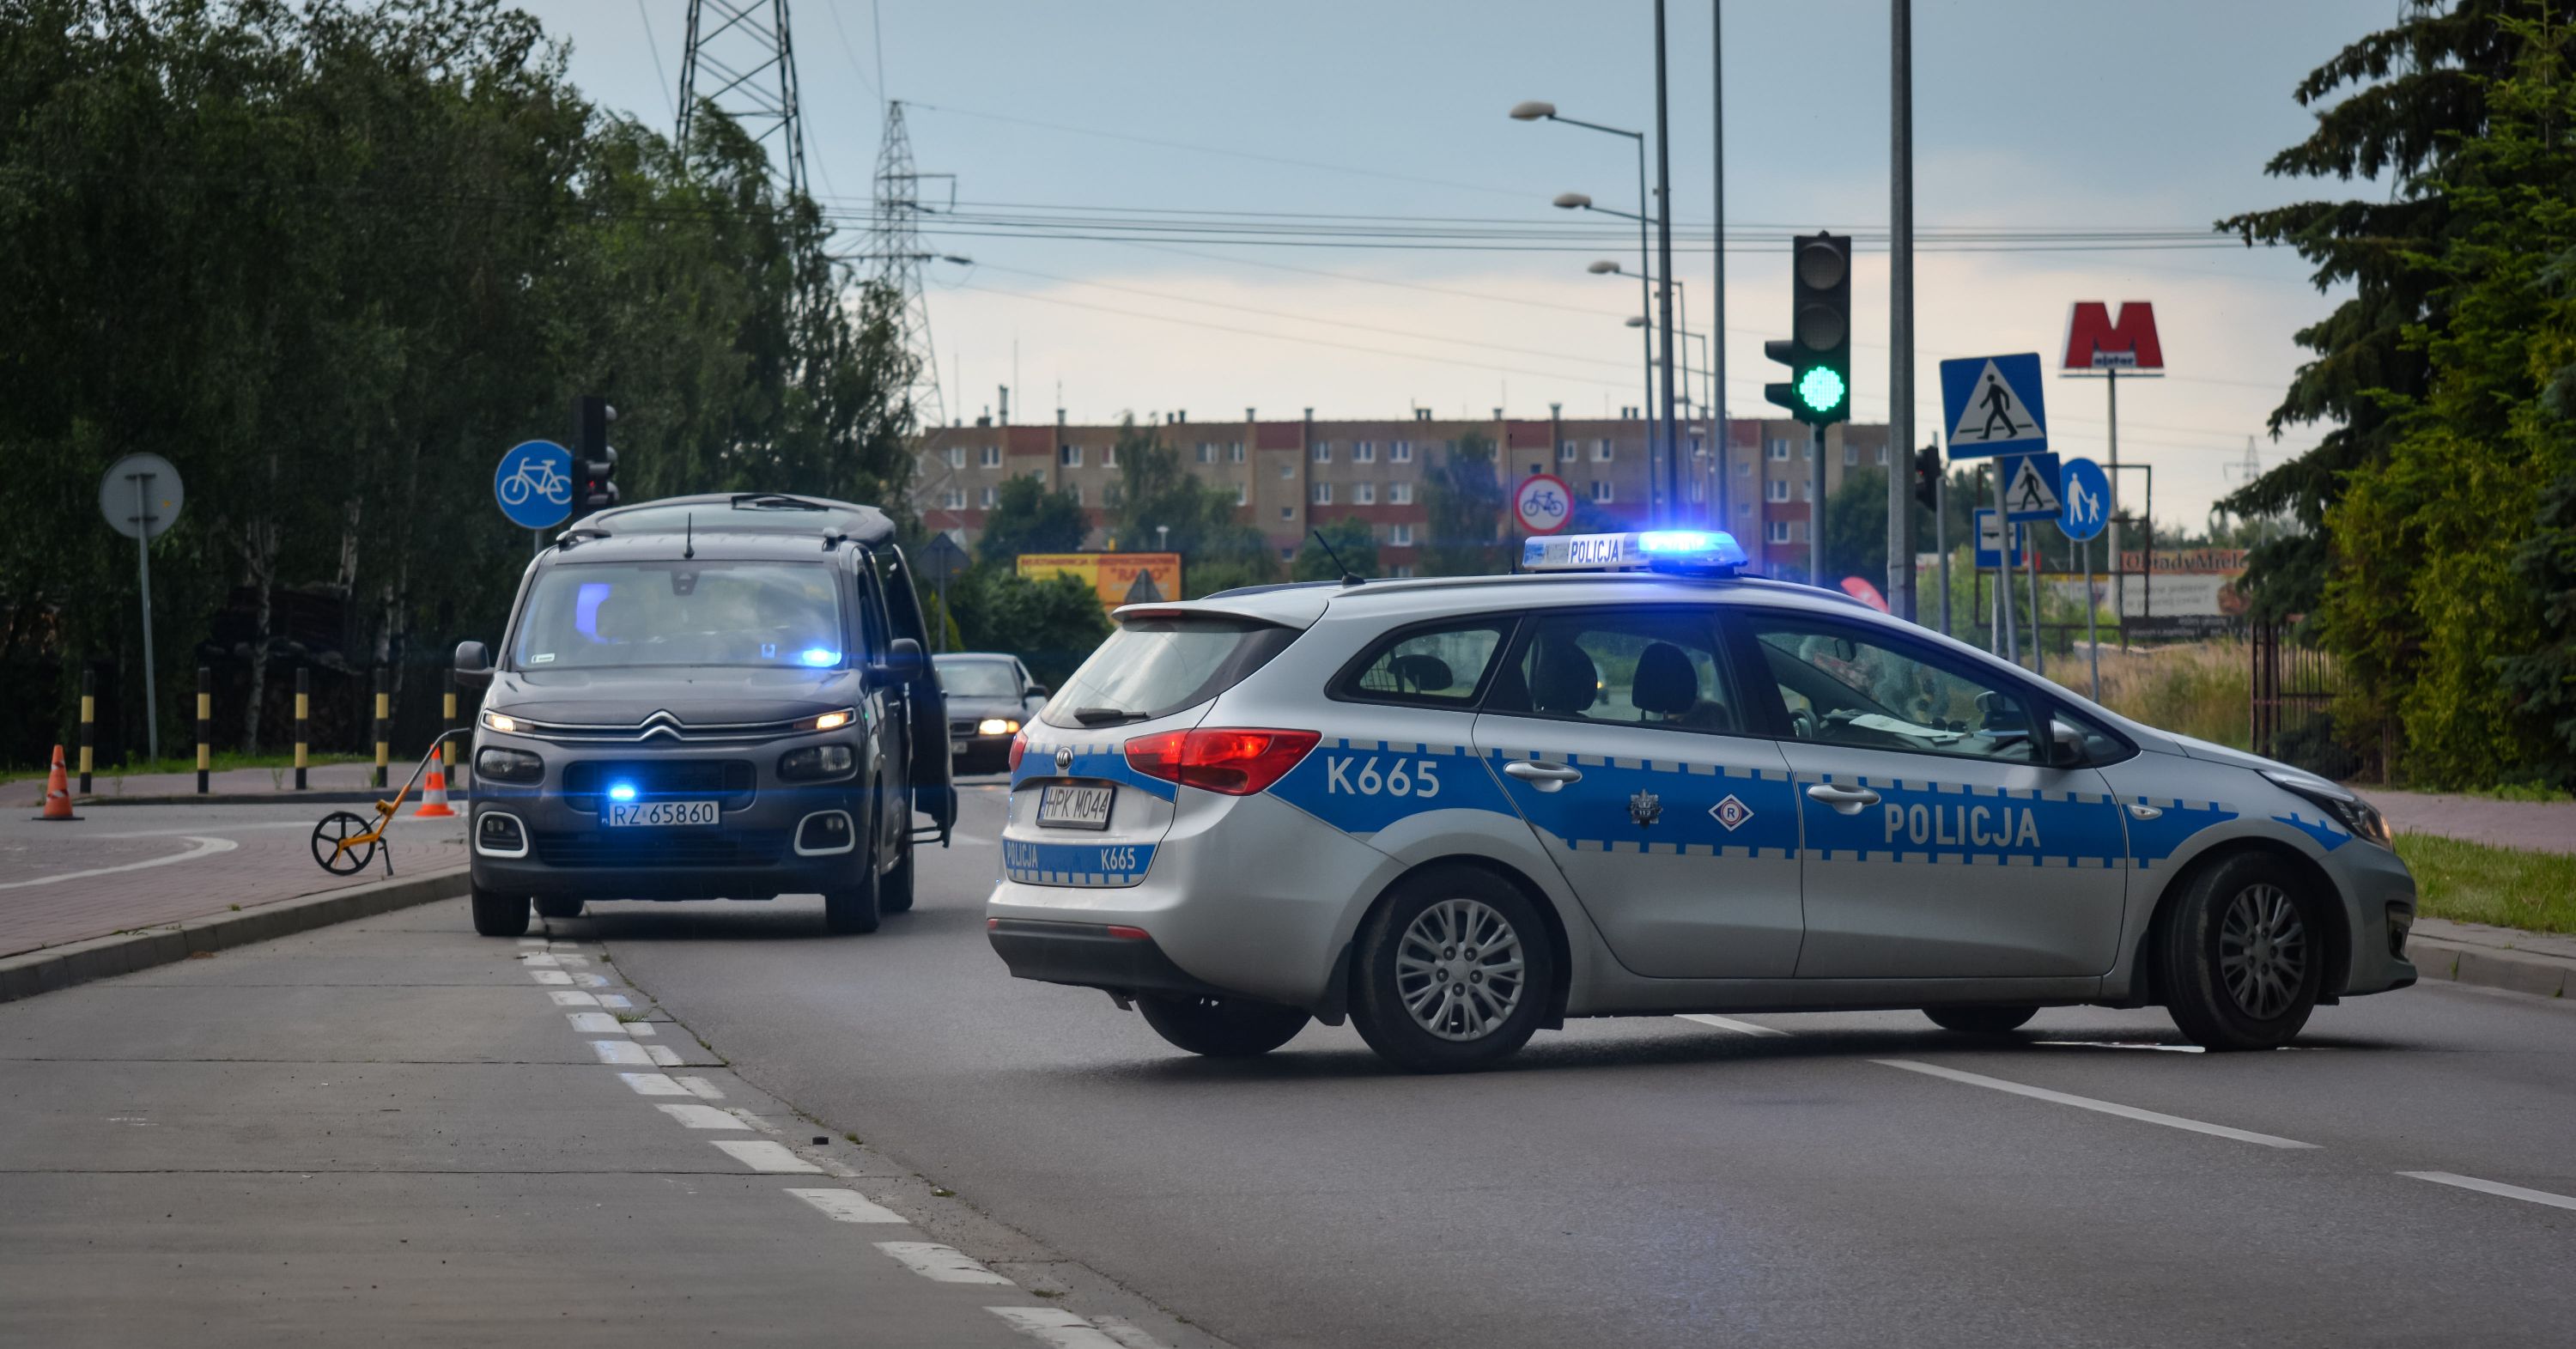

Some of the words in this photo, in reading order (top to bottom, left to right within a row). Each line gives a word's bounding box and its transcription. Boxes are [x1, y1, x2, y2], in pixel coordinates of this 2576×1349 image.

[1571, 539, 1619, 563] POLICJA
[1327, 756, 1440, 798] K665
[615, 805, 641, 824] RZ
[649, 803, 714, 823] 65860
[1045, 788, 1074, 817] HPK
[1073, 789, 1109, 819] M044
[1727, 807, 1735, 818] R
[1885, 803, 2041, 848] POLICJA
[1006, 842, 1038, 868] POLICJA
[1101, 846, 1136, 871] K665
